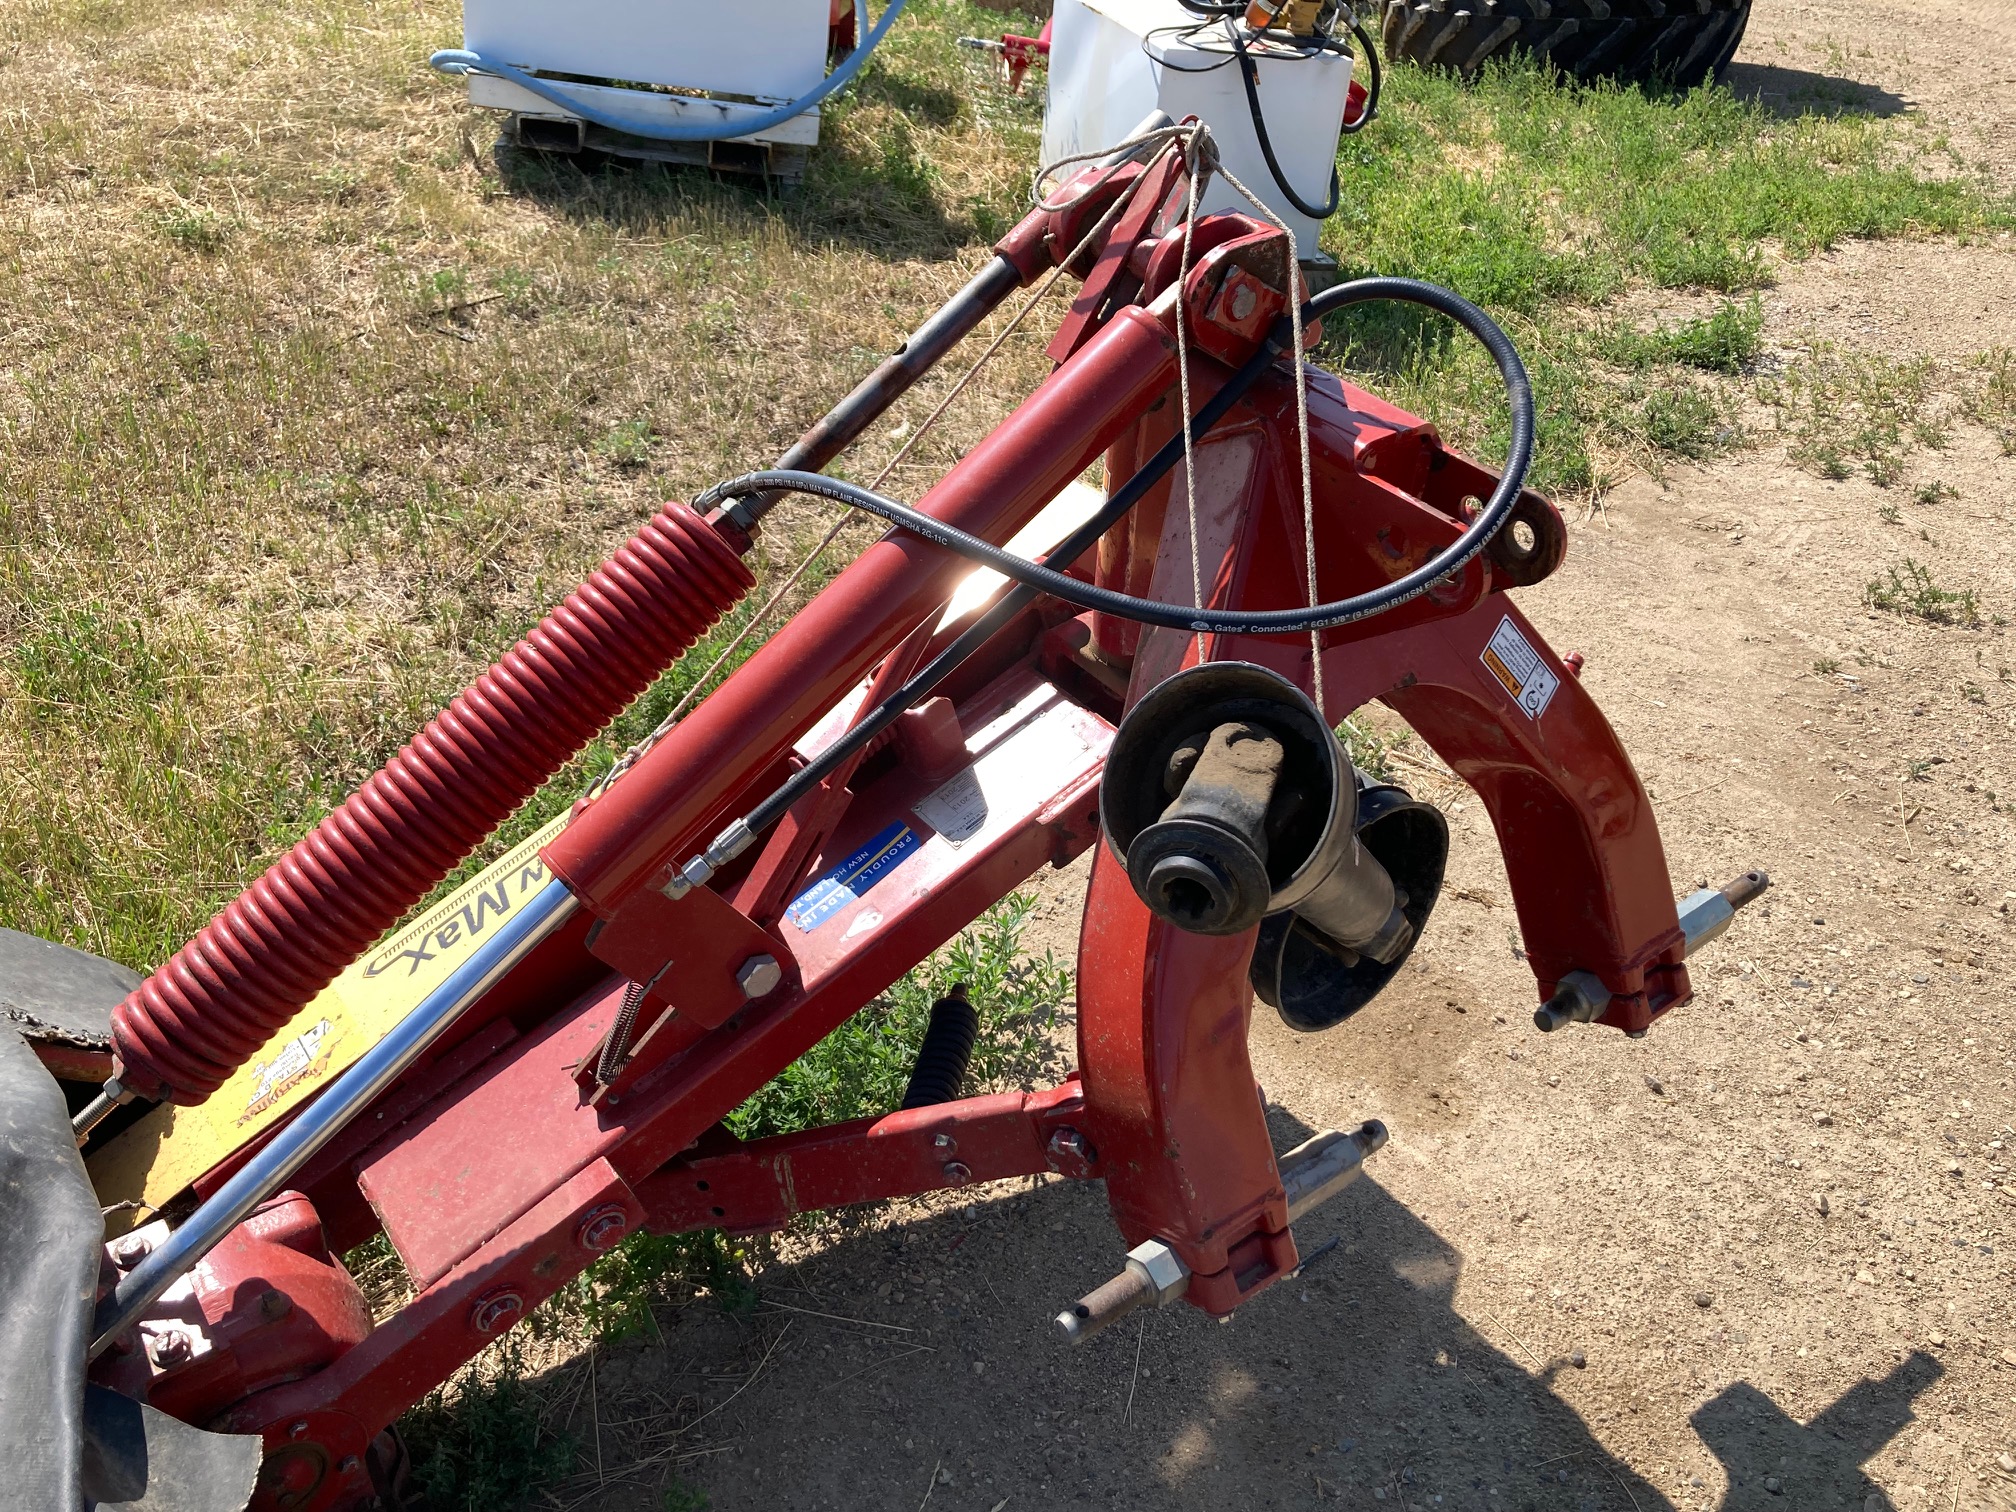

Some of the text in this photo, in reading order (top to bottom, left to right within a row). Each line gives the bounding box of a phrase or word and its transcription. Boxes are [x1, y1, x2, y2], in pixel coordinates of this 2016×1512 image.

[775, 478, 784, 486] PSI
[810, 483, 822, 494] MAX
[822, 486, 832, 497] WP
[832, 490, 853, 504] FLAME
[853, 497, 891, 518] RESISTANT
[890, 512, 920, 533] USMSHA
[921, 528, 948, 546] 2G-11C
[1310, 620, 1328, 628] 6G1
[1331, 614, 1350, 624] 3/8"
[1352, 602, 1390, 620] (9.5mm)
[1390, 586, 1423, 606] R1/1SN
[1469, 544, 1482, 557] PSI
[1487, 654, 1510, 683] WARNING
[952, 796, 970, 810] 2013
[801, 834, 912, 928] PROUDLY MADE IN
[848, 852, 869, 870] NEW
[401, 880, 511, 977] Max
